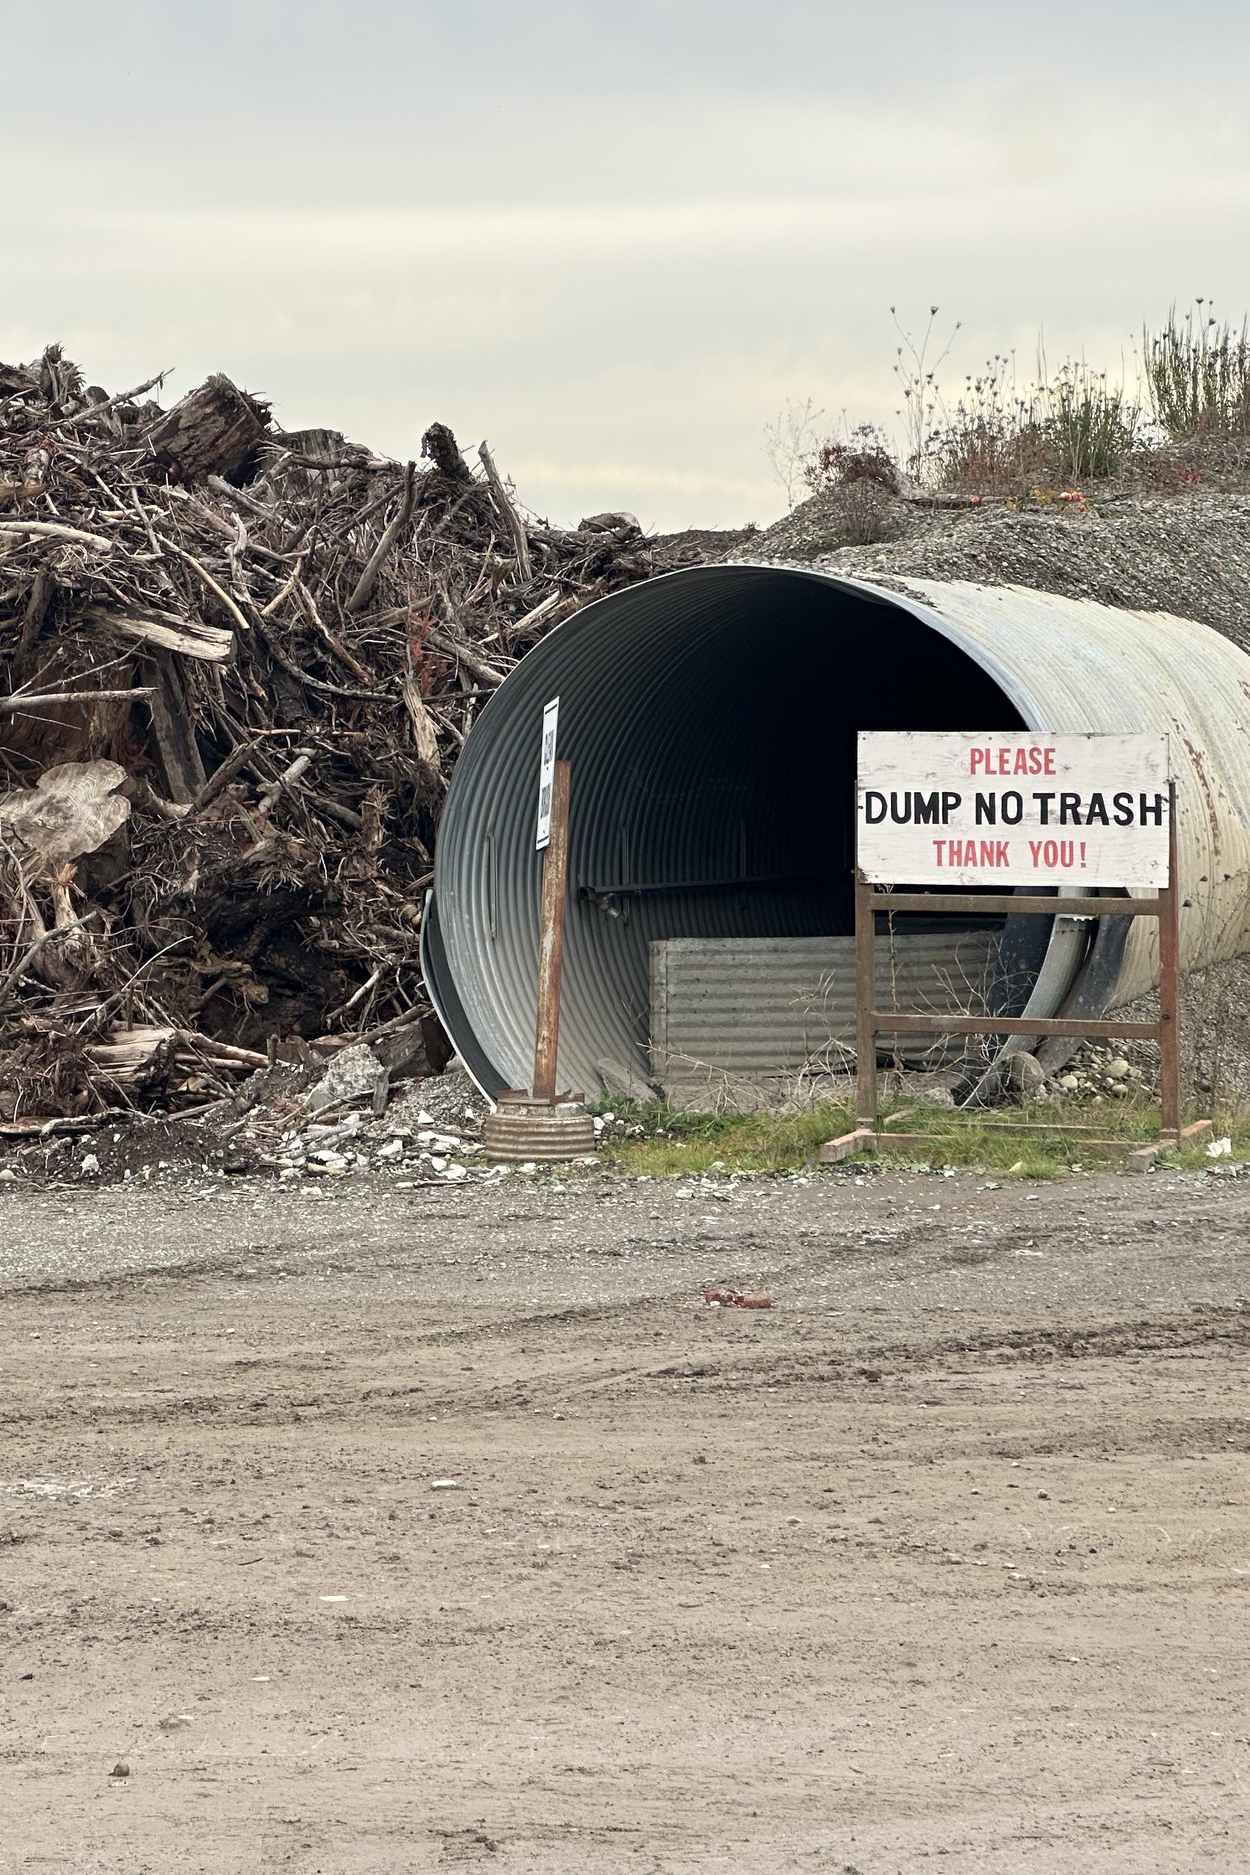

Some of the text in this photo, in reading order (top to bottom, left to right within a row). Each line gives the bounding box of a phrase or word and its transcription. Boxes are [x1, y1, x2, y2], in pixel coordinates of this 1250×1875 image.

[969, 746, 1056, 775] PLEASE
[865, 790, 1162, 826] DUMP NO TRASH
[933, 840, 1087, 868] THANK YOU!
